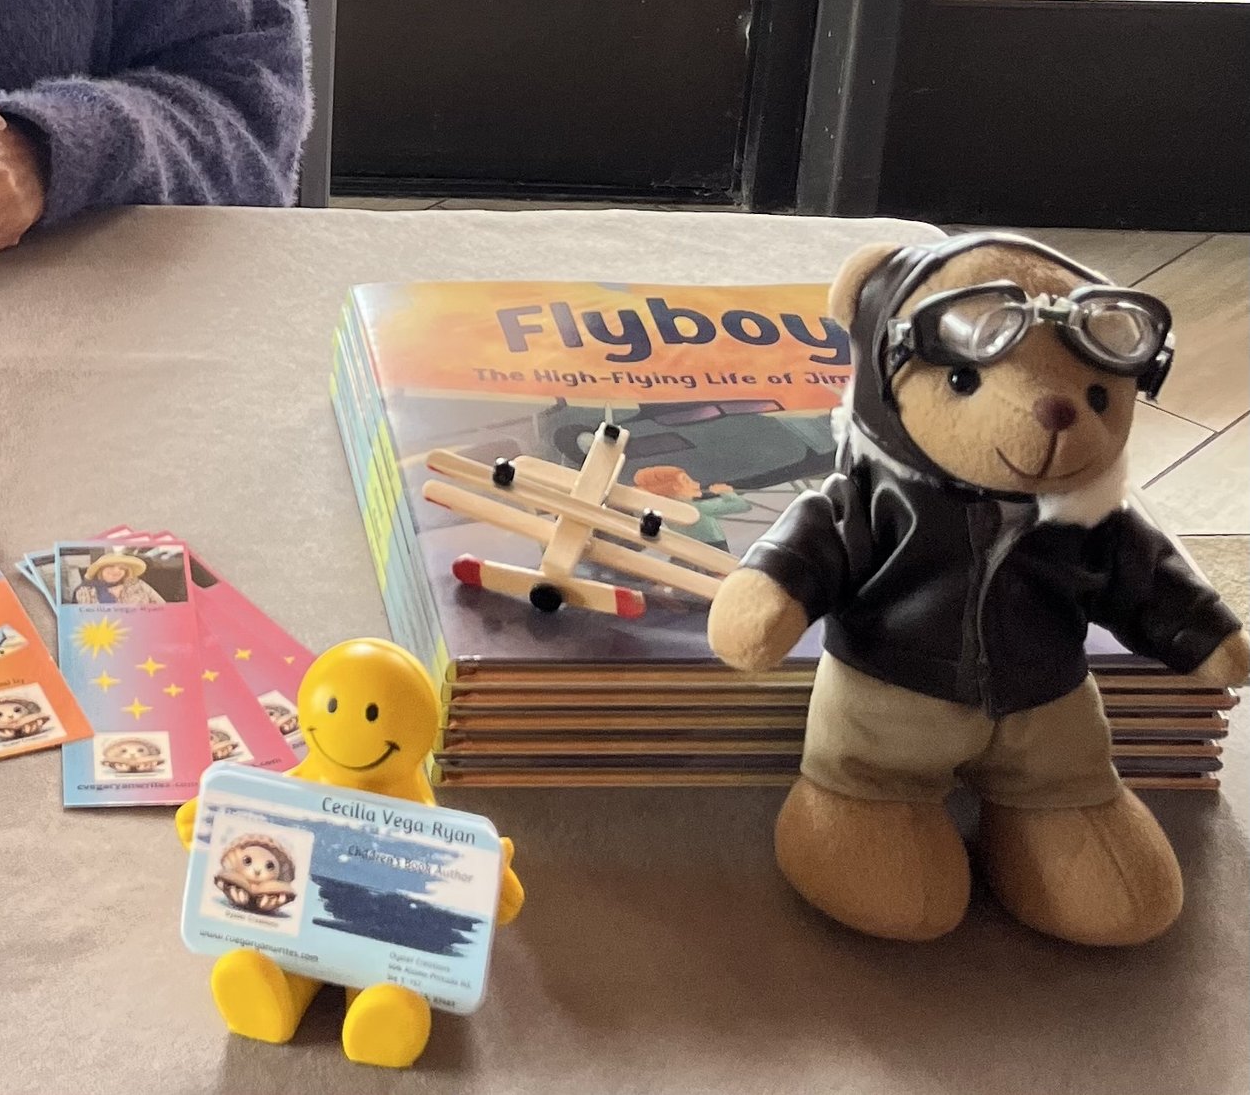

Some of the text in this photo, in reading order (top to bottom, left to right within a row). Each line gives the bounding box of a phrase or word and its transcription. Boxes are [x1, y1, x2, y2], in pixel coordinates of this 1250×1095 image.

[496, 297, 851, 366] Flyboy
[473, 367, 525, 383] The
[534, 369, 697, 389] High-Flying
[705, 372, 757, 385] Life
[766, 372, 793, 385] of
[322, 797, 376, 822] Cecilia
[348, 844, 474, 883] Children's Book Author
